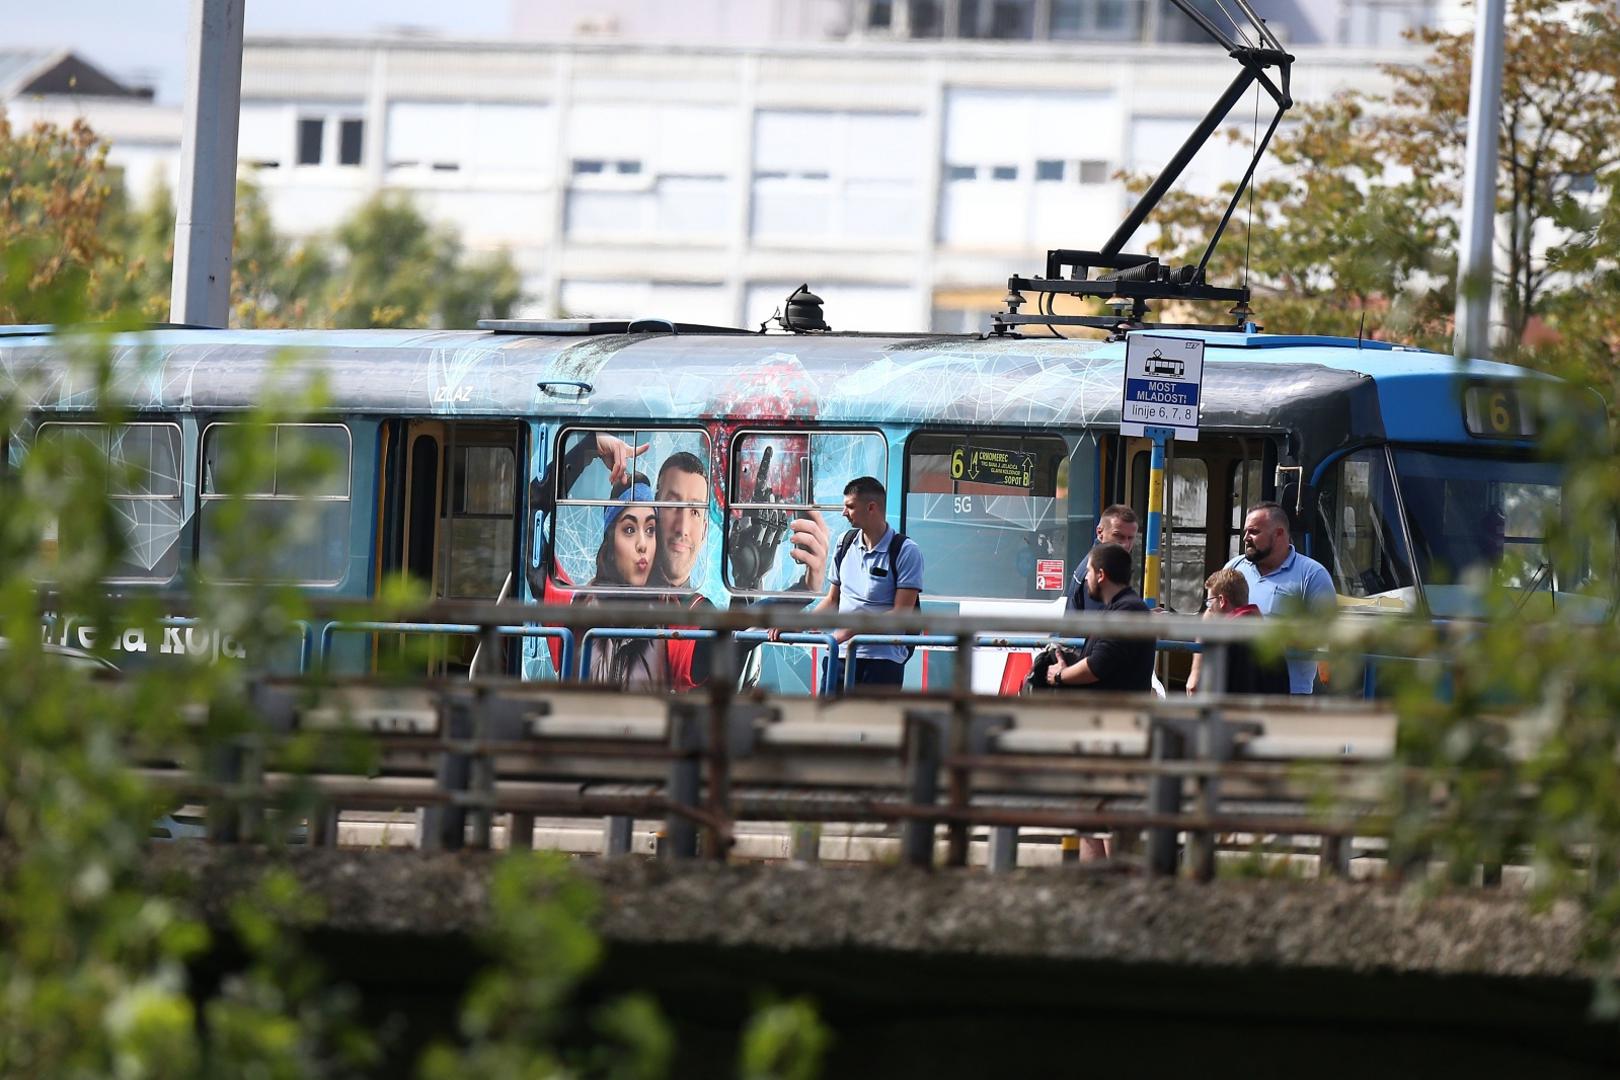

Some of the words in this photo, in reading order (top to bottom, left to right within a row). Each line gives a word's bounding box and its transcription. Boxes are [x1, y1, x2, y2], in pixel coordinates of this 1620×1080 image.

[1148, 382, 1176, 392] MOST
[1136, 391, 1187, 404] MLADOSTI
[1132, 404, 1155, 419] linije
[1158, 407, 1168, 419] 6,
[1172, 408, 1181, 420] 7,
[1184, 408, 1192, 420] 8
[1489, 392, 1510, 433] 6
[952, 448, 963, 478] 6
[1004, 476, 1021, 485] SOPOT
[954, 496, 971, 513] 5G
